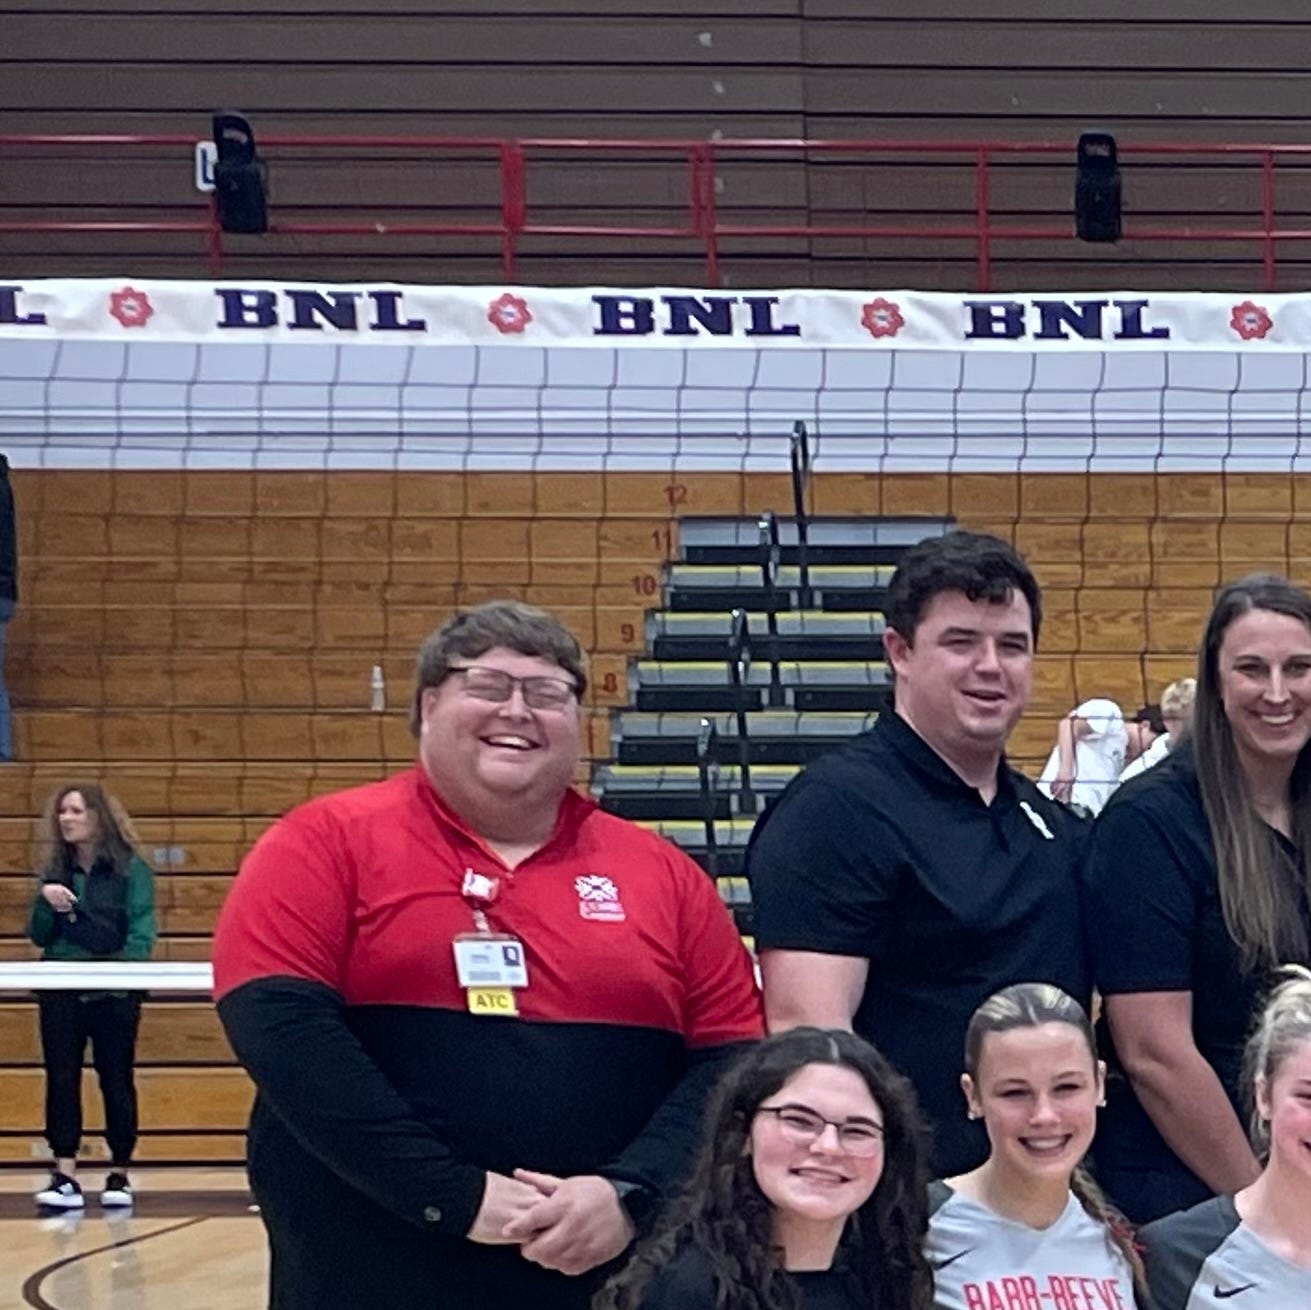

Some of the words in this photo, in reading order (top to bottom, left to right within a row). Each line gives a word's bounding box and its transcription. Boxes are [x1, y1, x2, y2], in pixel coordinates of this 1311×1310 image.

[216, 290, 425, 331] BNL
[593, 297, 800, 337] BNL
[965, 301, 1169, 340] BNL
[632, 574, 656, 595] 10
[620, 623, 635, 643] 9
[475, 992, 509, 1009] ATC
